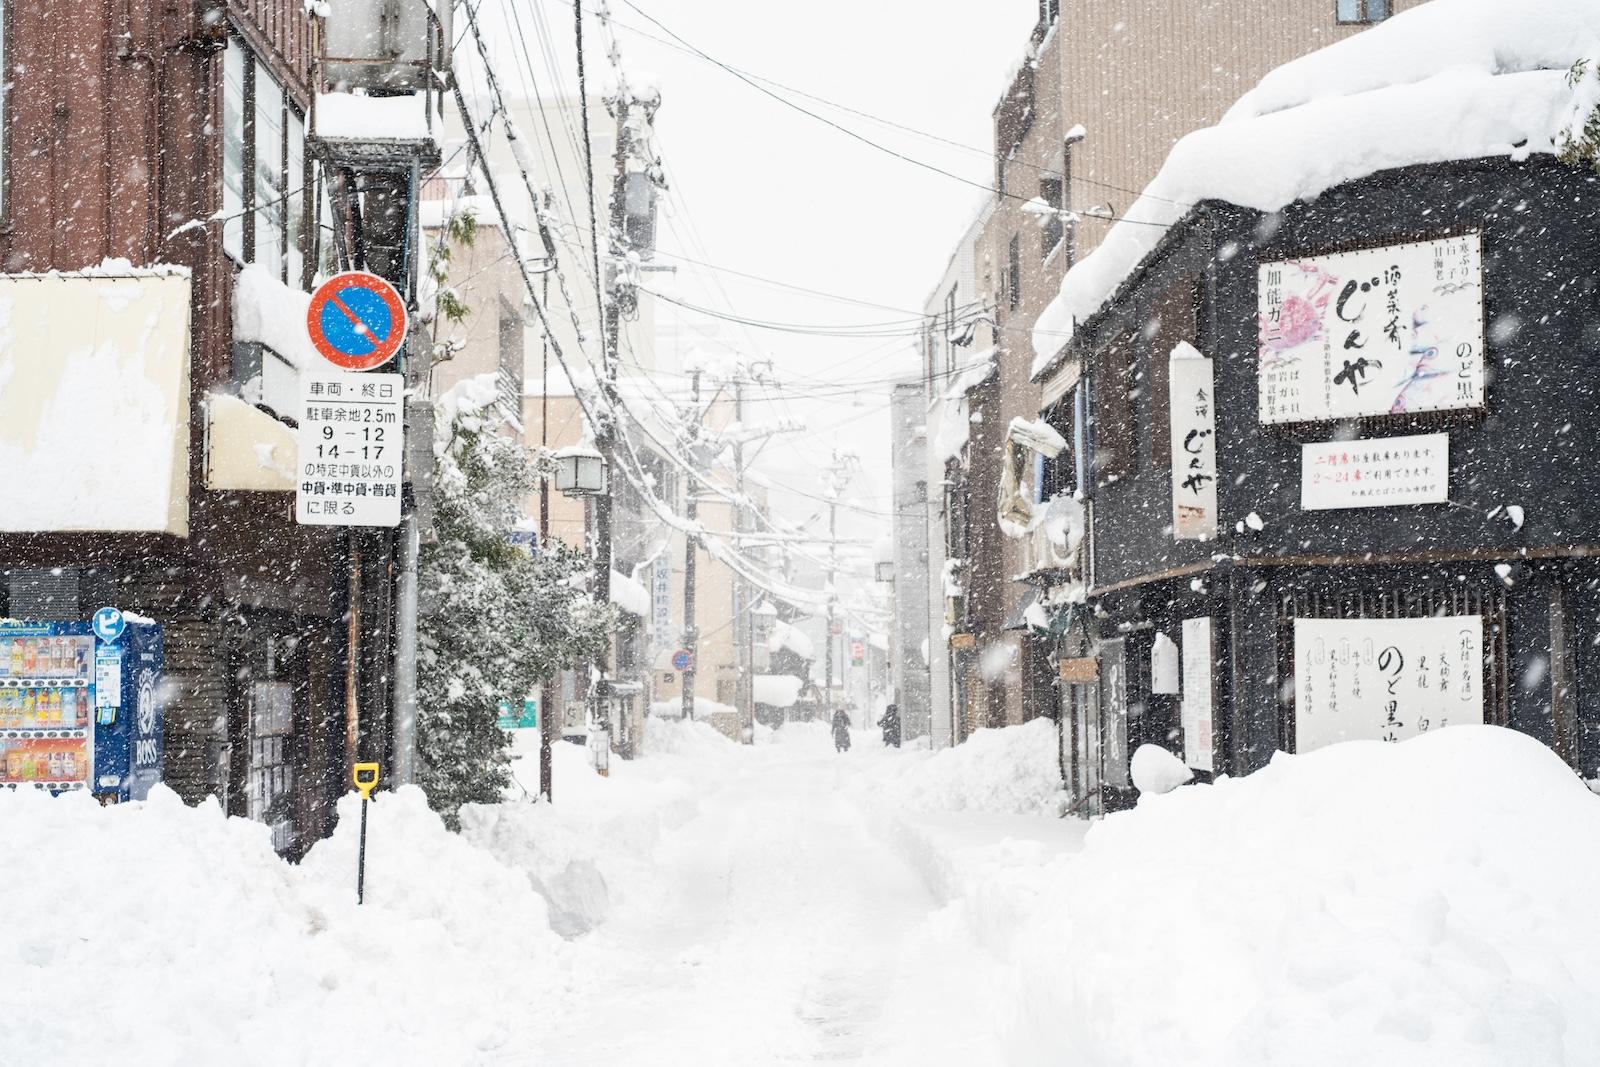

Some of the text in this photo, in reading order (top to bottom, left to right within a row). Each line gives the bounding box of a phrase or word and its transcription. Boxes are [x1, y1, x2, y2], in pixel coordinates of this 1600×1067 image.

[1266, 269, 1282, 342] 加能ガニ
[1334, 277, 1382, 395] じんや
[1456, 342, 1473, 400] のど黒
[309, 381, 394, 398] 車両・終日
[306, 407, 396, 424] 駐車余地2.5m
[305, 463, 394, 480] の特定中貨以外の
[1181, 428, 1212, 496] じんや
[302, 481, 396, 498] 中貨・準中貨・普貨
[306, 500, 355, 516] に限る
[98, 612, 119, 635] ピ
[136, 739, 157, 765] BOSS
